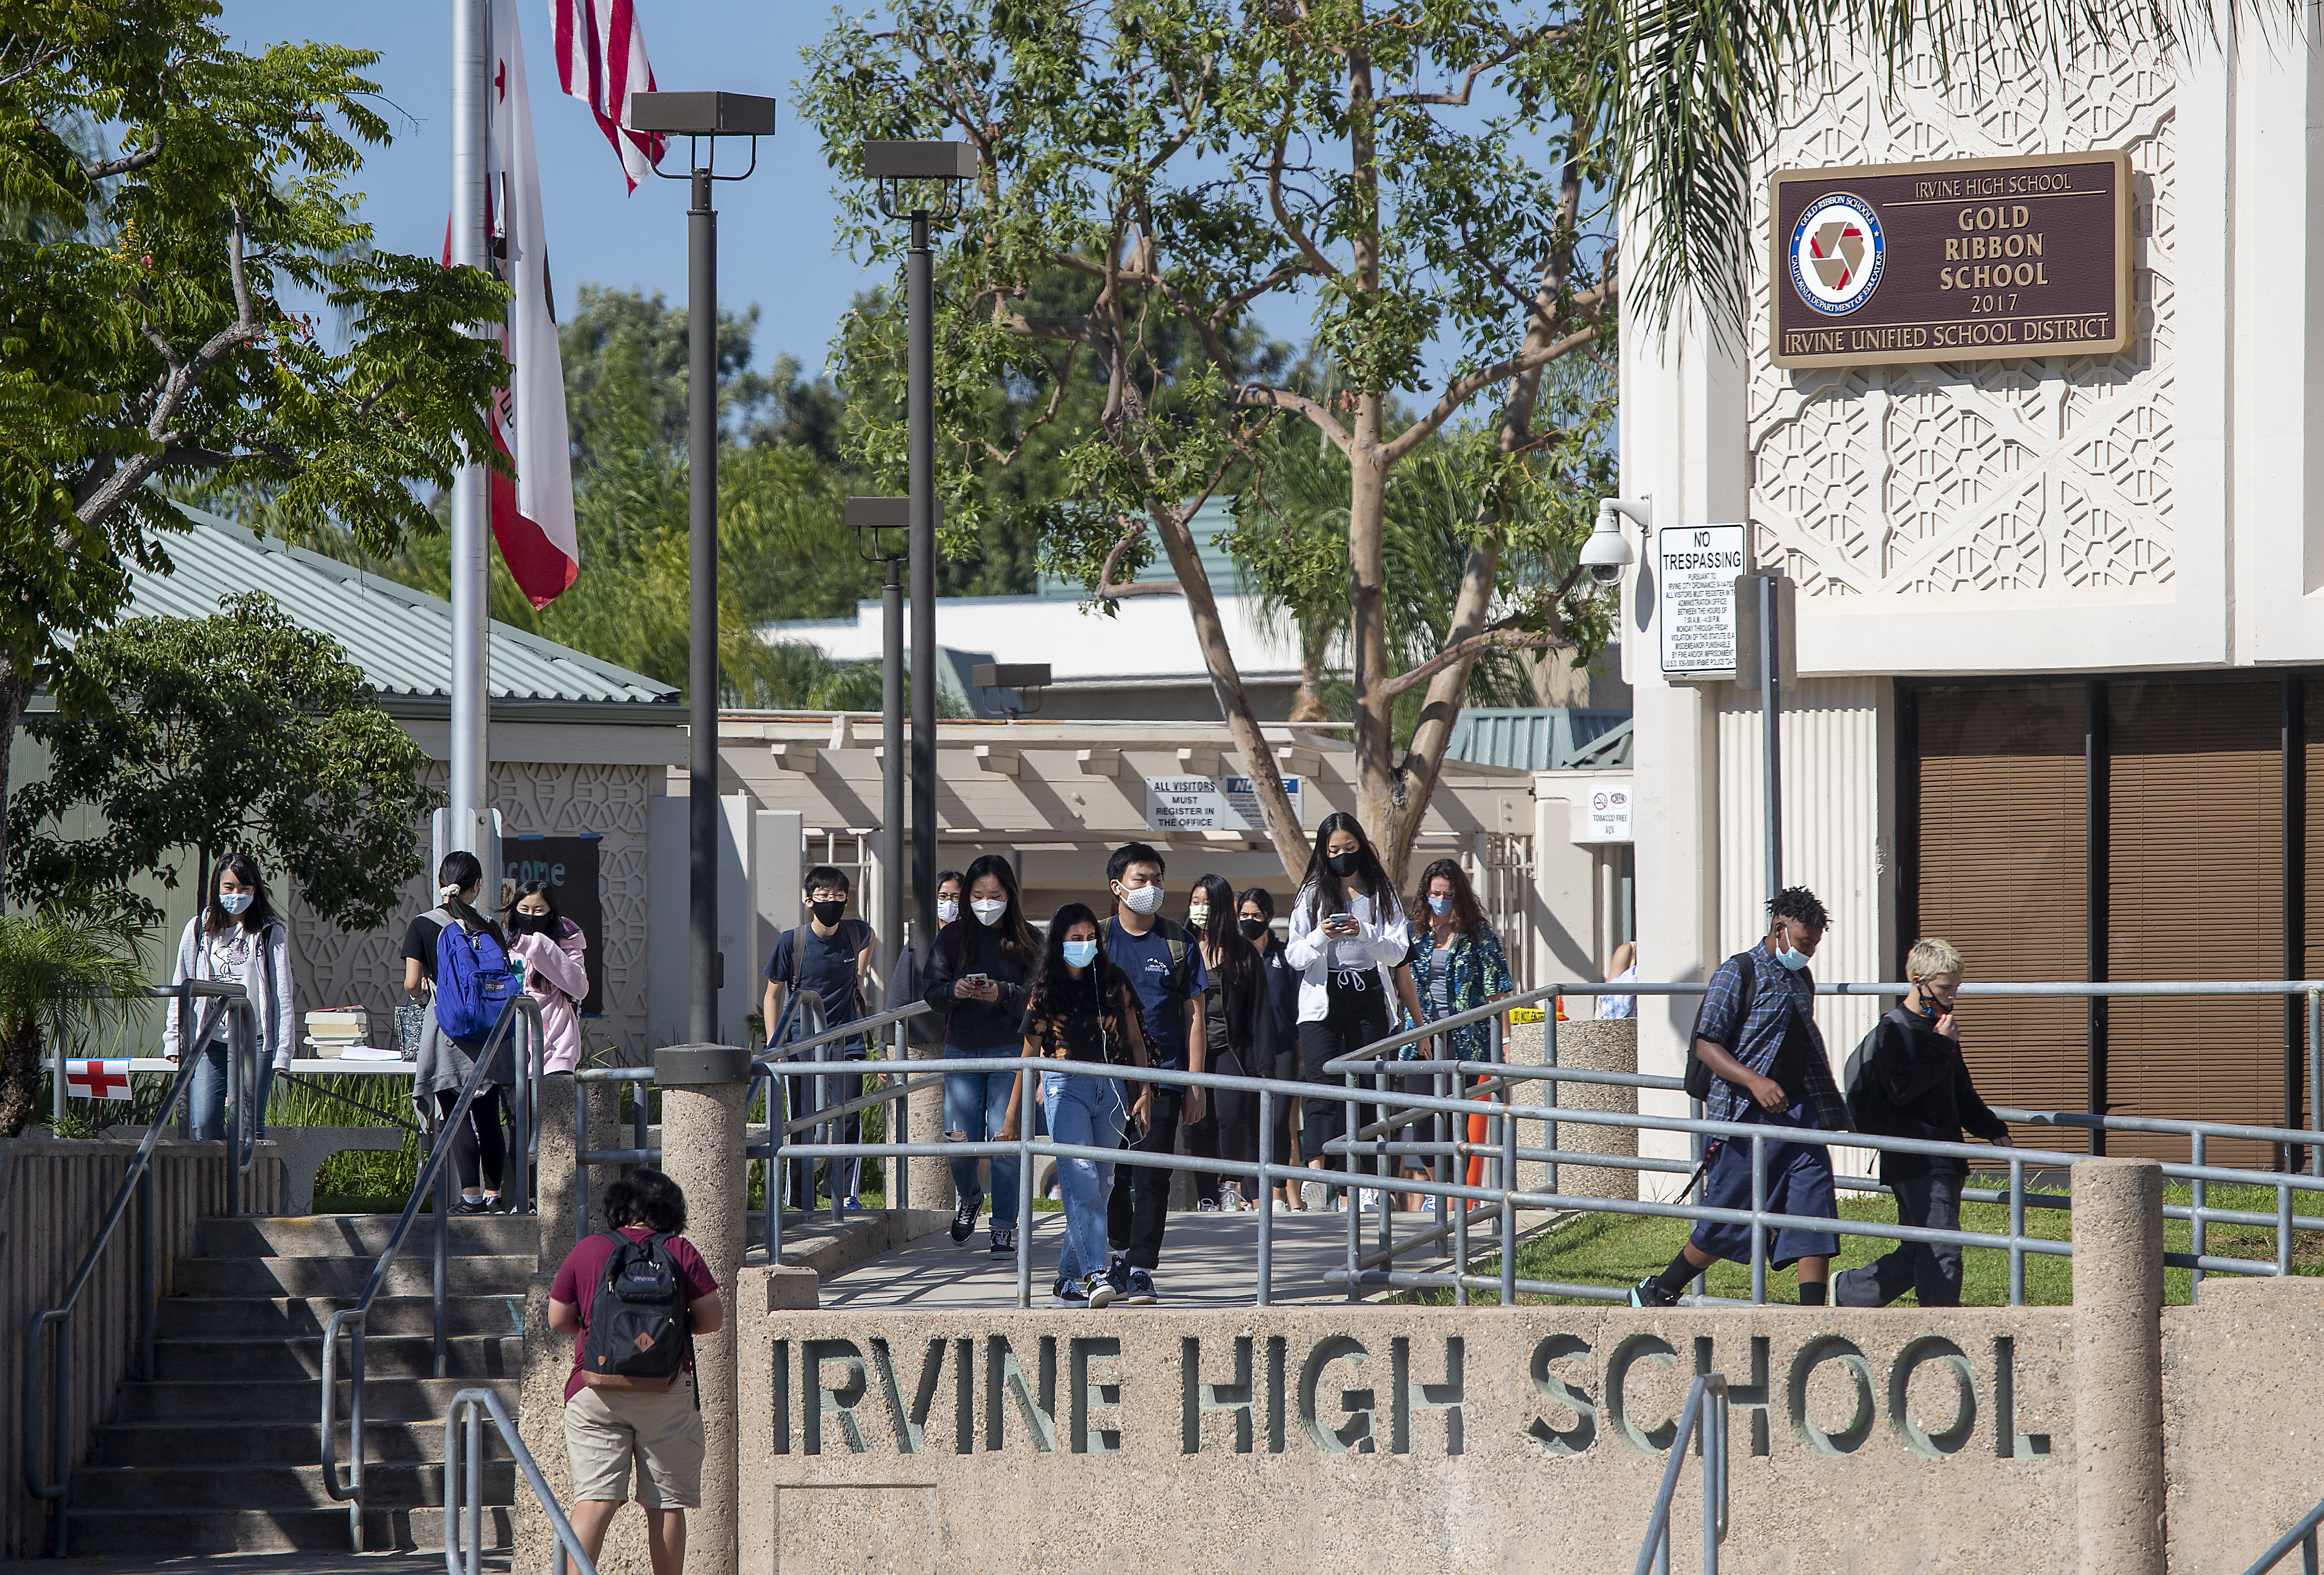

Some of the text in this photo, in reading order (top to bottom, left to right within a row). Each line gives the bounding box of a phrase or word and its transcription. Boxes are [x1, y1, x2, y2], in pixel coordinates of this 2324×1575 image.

[1916, 174, 2073, 198] IRVINE HIGH SCHOOL
[1801, 195, 1875, 226] GOLD RIBBON SCHOOLS
[1958, 205, 2030, 231] GOLD
[1945, 233, 2044, 261] RIBBON
[1791, 251, 1882, 312] CALIFORNIA DEPARTMENT OF EDUCATION
[1940, 262, 2048, 291] SCHOOL
[1971, 293, 2018, 313] 2017
[1784, 318, 2109, 354] IRVINE UNIFIED SCHOOL DISTRICT
[1694, 531, 1711, 548] NO
[1663, 551, 1741, 571] TRESPASSING
[1154, 781, 1216, 792] ALL VISITORS
[1158, 818, 1213, 827] THE OFFICE
[502, 860, 566, 887] come
[1521, 1011, 1530, 1021] NOT
[1531, 1011, 1545, 1021] ENTE
[773, 1333, 2052, 1460] IRVINE HIGH SCHOOL
